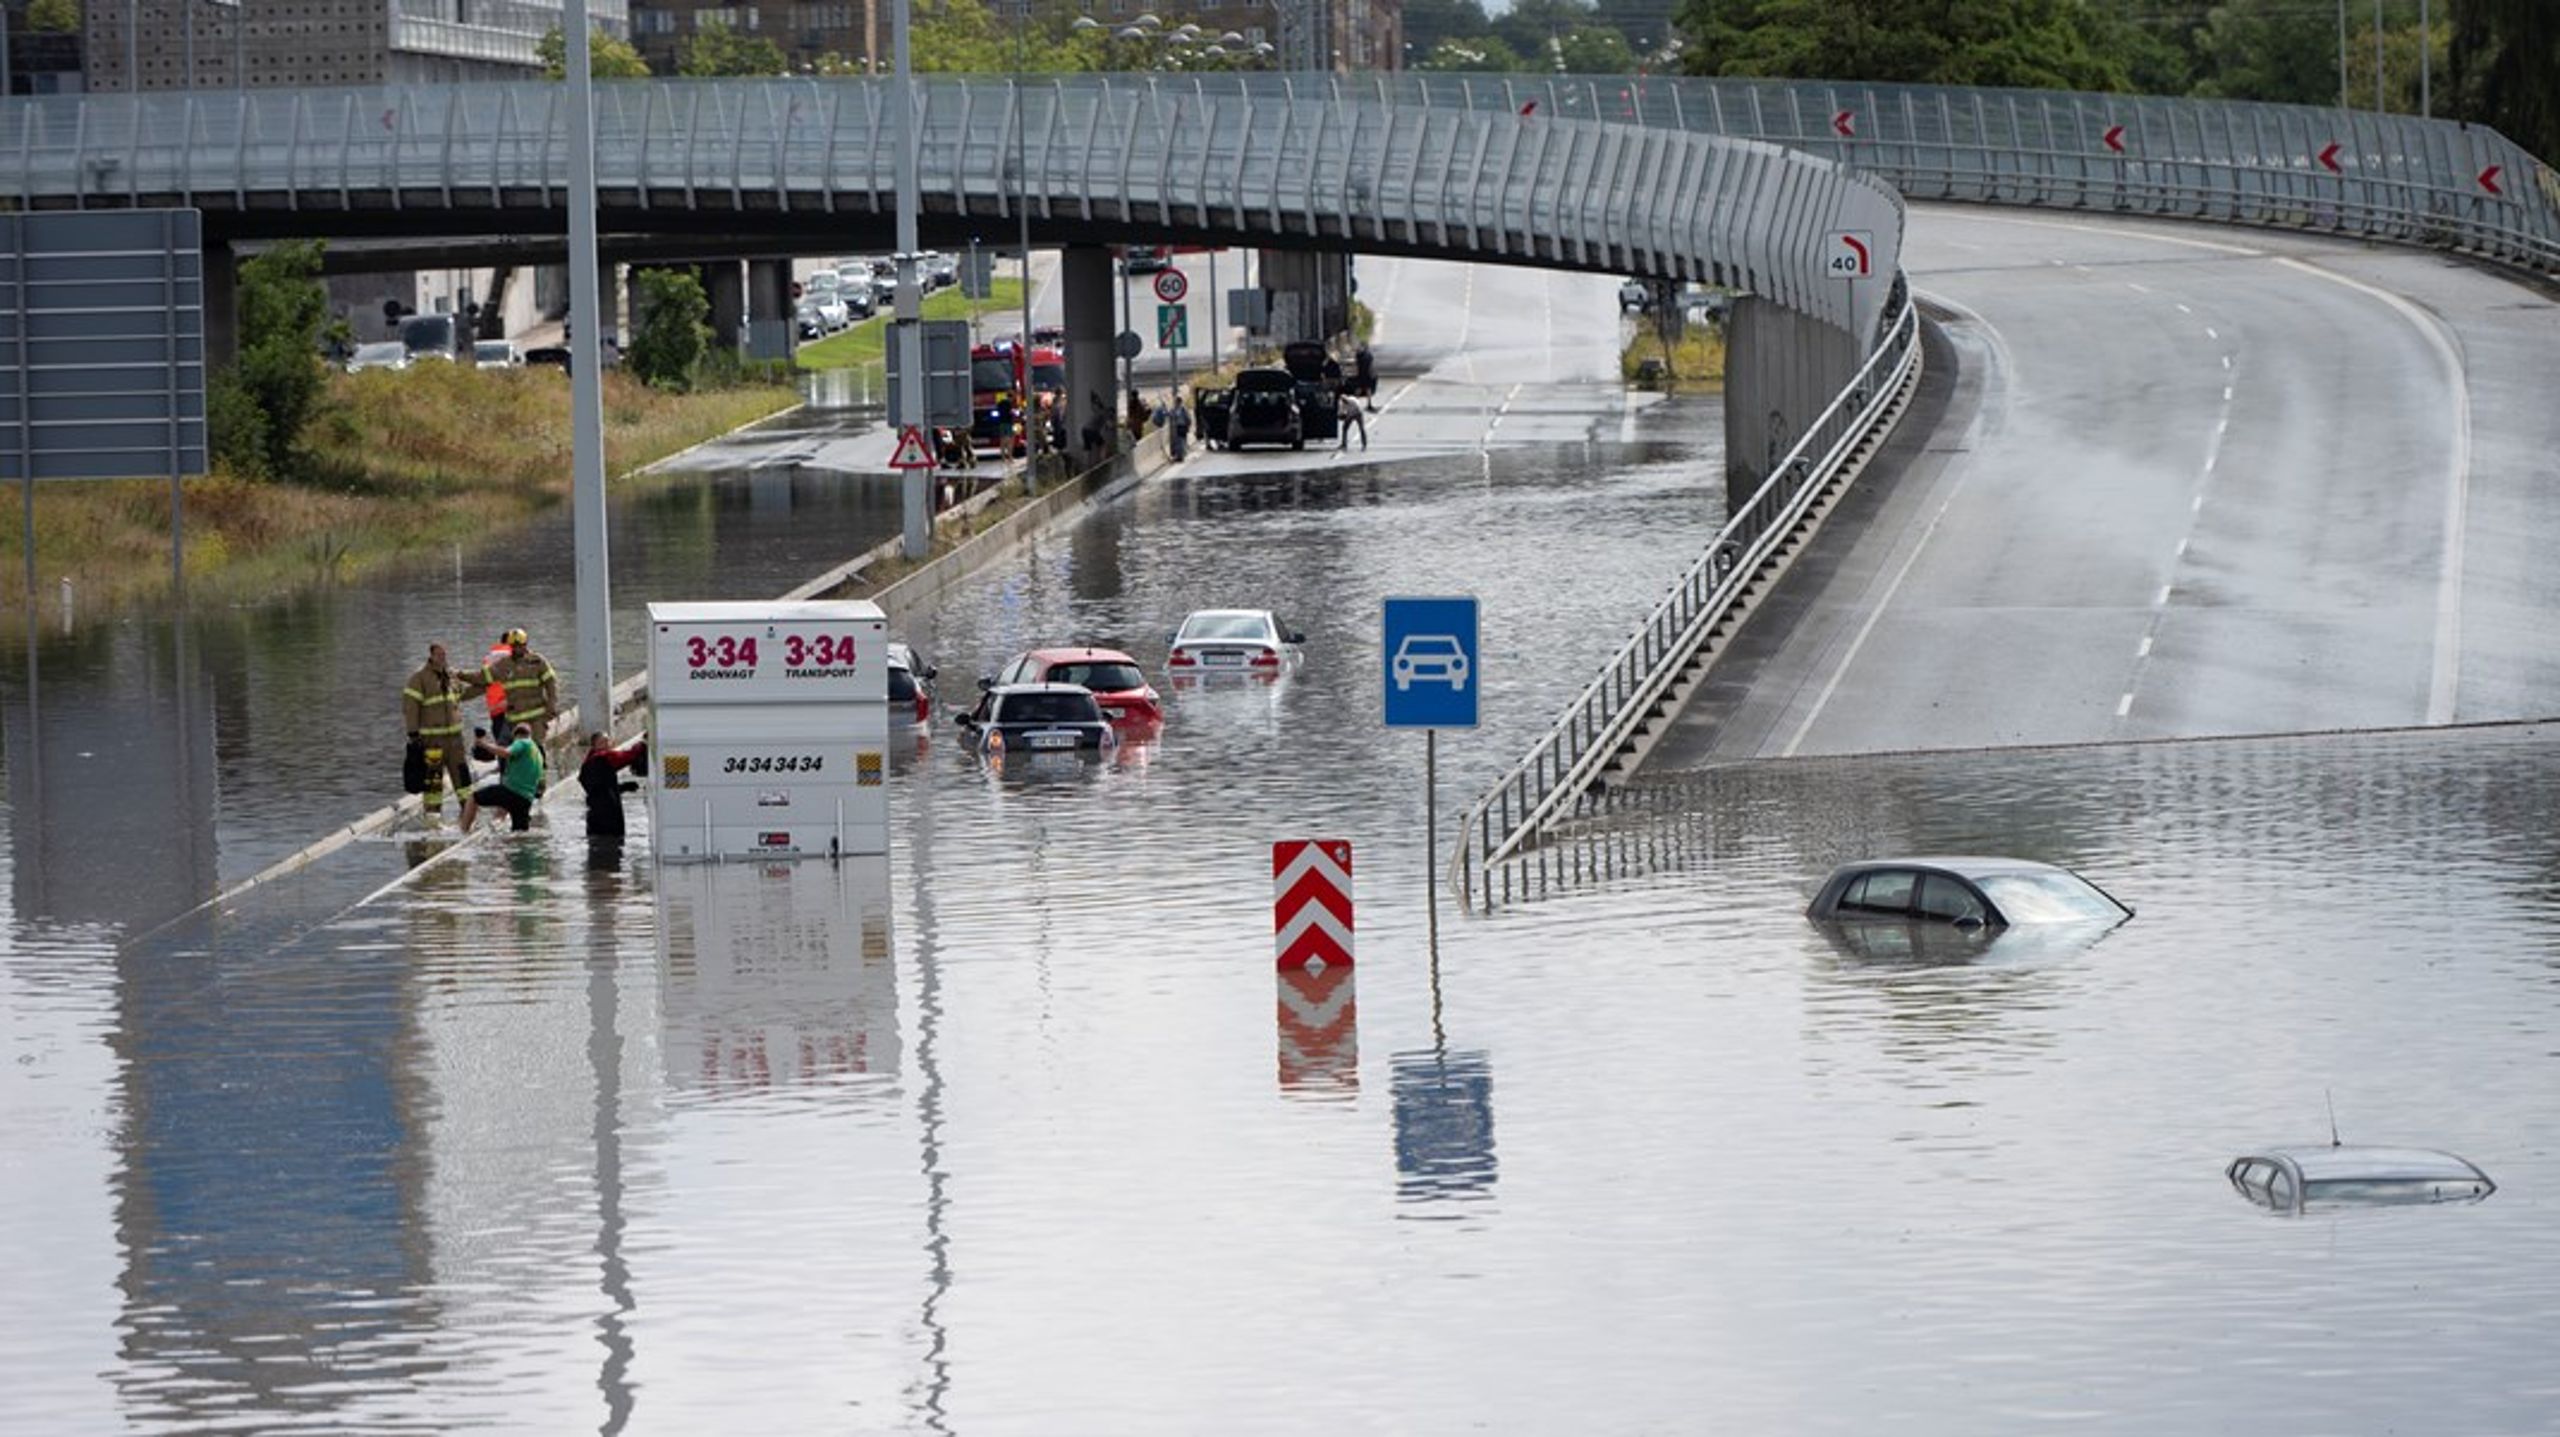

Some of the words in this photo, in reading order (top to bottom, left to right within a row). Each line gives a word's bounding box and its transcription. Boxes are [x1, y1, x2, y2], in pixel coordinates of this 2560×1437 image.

[1832, 256, 1857, 271] 40
[1161, 279, 1182, 293] 60
[785, 668, 856, 678] TRANSPORT
